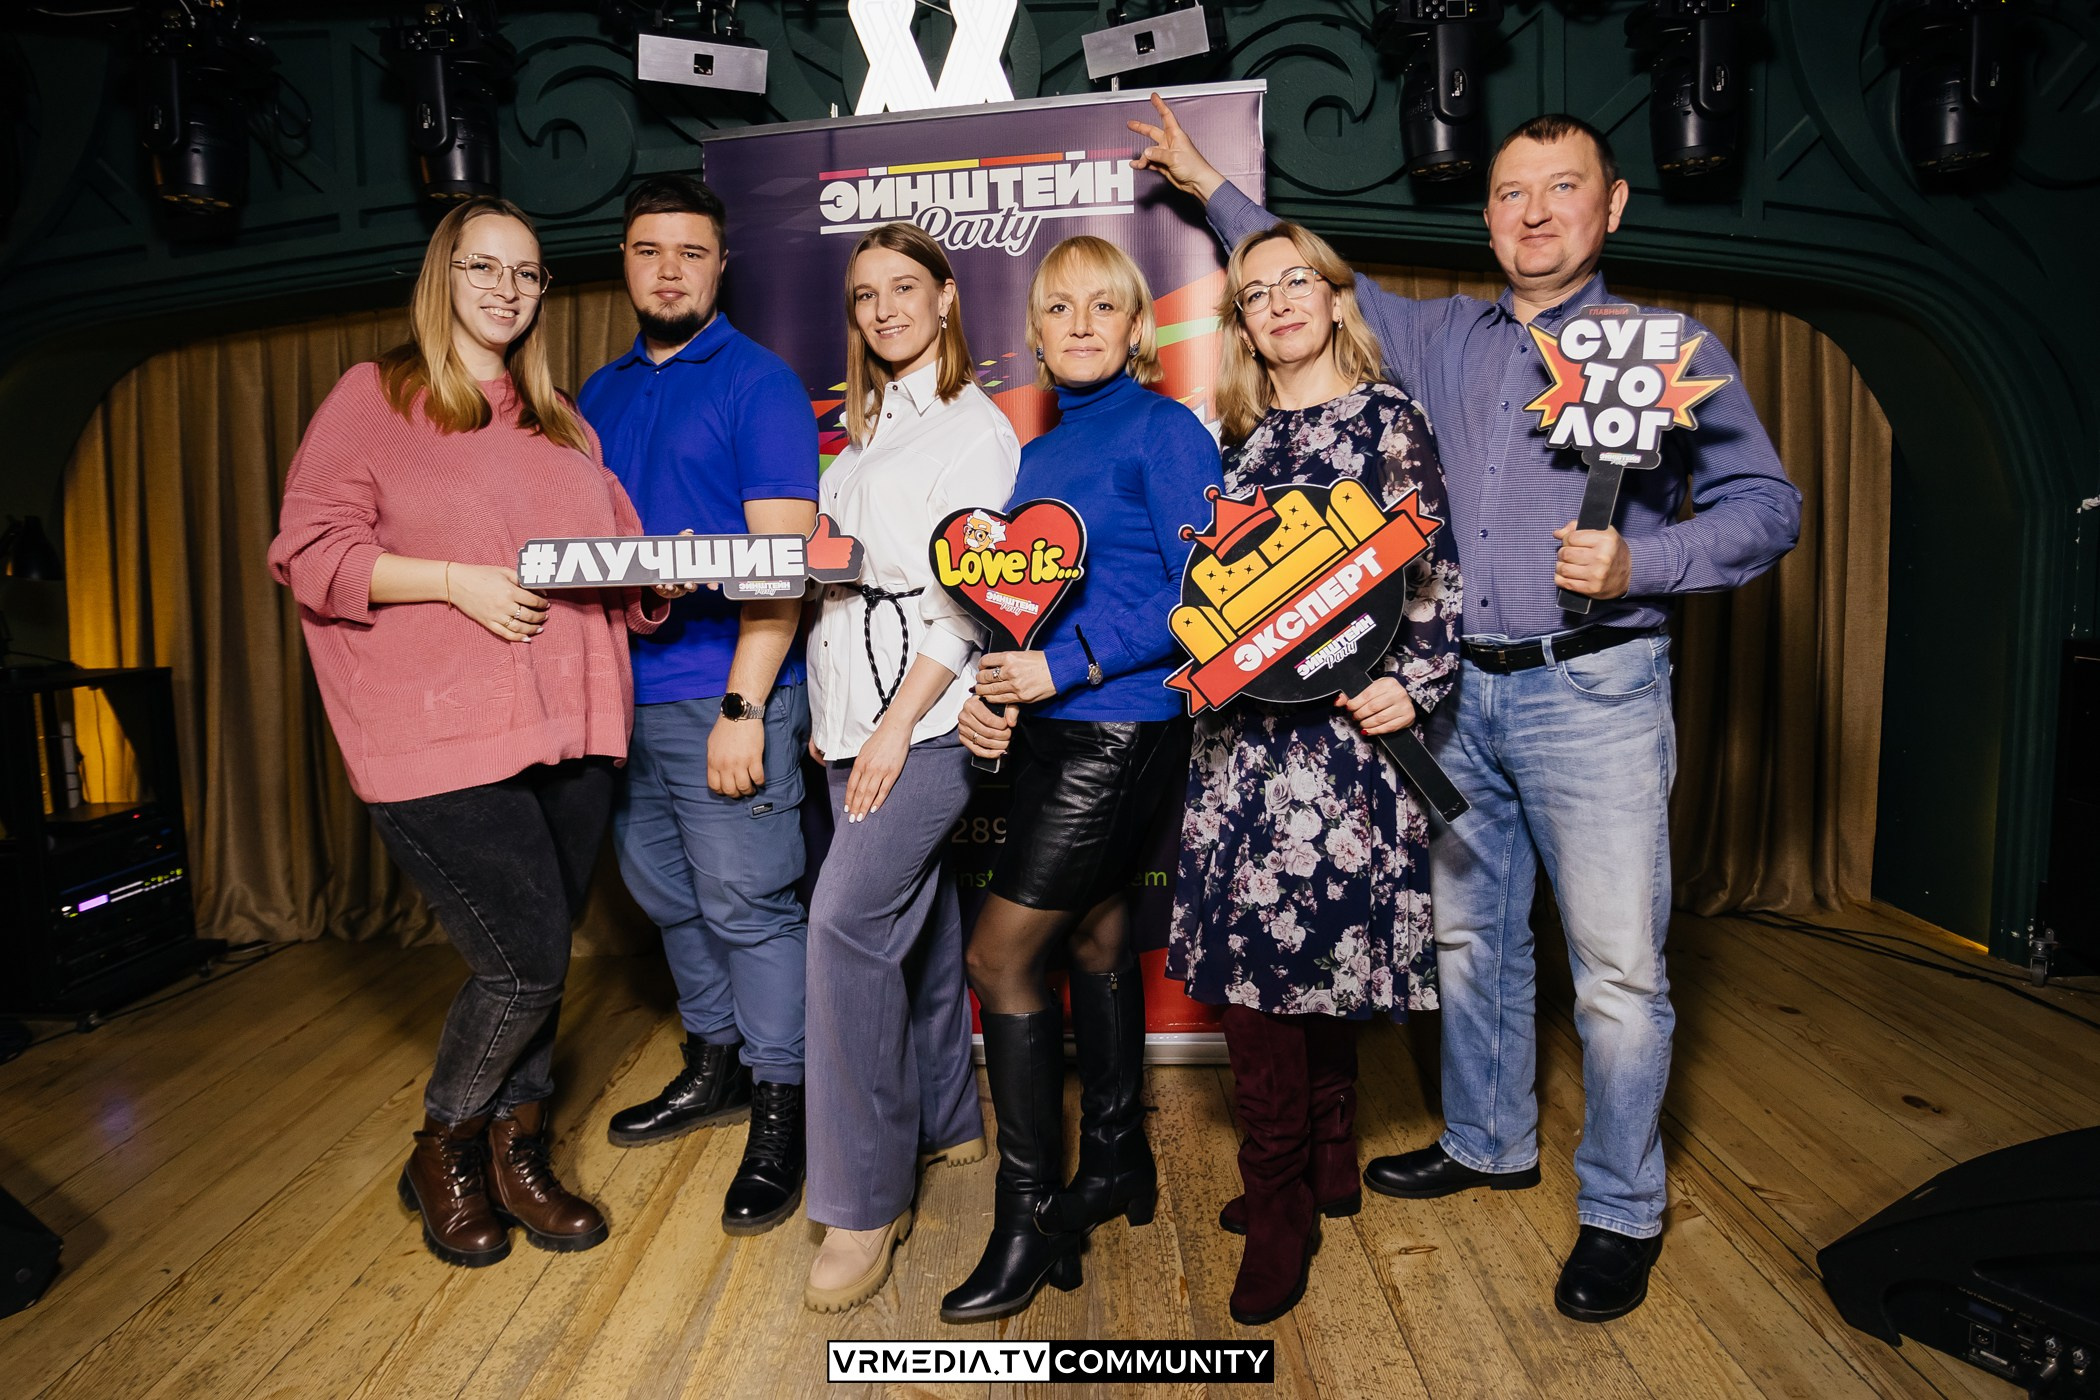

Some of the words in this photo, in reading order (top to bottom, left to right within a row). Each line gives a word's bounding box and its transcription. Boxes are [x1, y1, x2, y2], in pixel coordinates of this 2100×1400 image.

[820, 150, 1135, 222] ЭЙНШТЕЙН
[915, 203, 1043, 256] Party
[1589, 306, 1630, 316] ГЛАВНЫЙ
[1560, 319, 1680, 360] СУЕ
[1583, 361, 1663, 408] ТО
[1548, 406, 1672, 450] ЛОГ
[520, 538, 805, 584] #ЛУЧШИЕ
[934, 537, 1028, 587] Love
[1030, 538, 1081, 584] is...
[1233, 547, 1384, 672] ЭКСПЕРТ
[1326, 640, 1358, 669] Party
